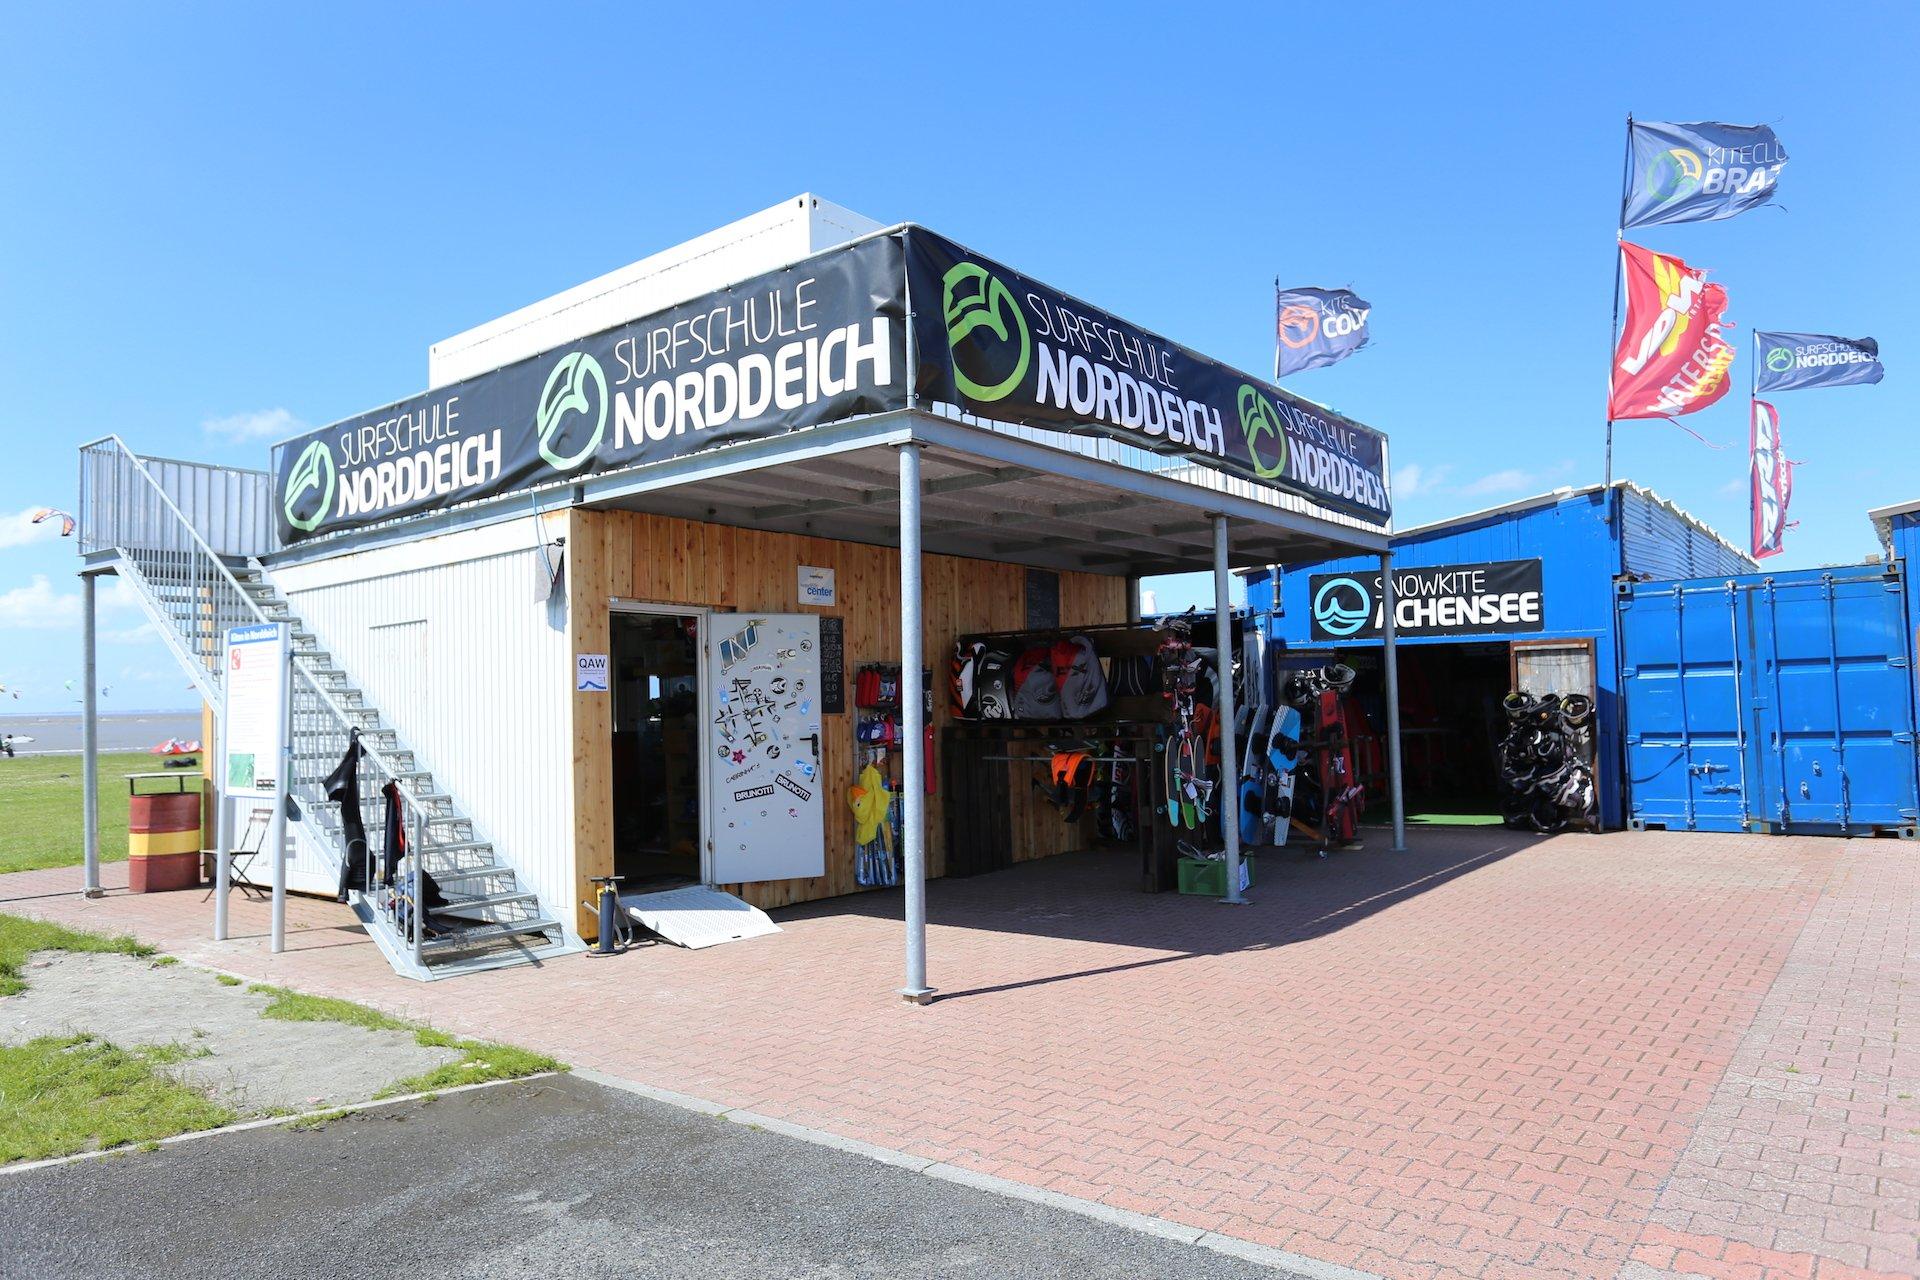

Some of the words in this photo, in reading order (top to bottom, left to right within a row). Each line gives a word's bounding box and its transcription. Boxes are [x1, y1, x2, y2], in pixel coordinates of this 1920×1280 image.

[614, 277, 818, 387] SURFSCHULE
[1026, 292, 1179, 391] SURFSCHULE
[613, 316, 892, 450] NORDDEICH
[1035, 342, 1226, 457] NORDDEICH
[339, 396, 460, 469] SURFSCHULE
[1277, 400, 1359, 462] SURFSCHULE
[336, 429, 501, 517] NORDDEICH
[1287, 436, 1387, 512] NORDDEICH
[807, 587, 833, 597] center
[579, 658, 606, 669] QAW
[735, 786, 774, 801] BRUNOTTI
[777, 775, 810, 800] BRUNOTTI
